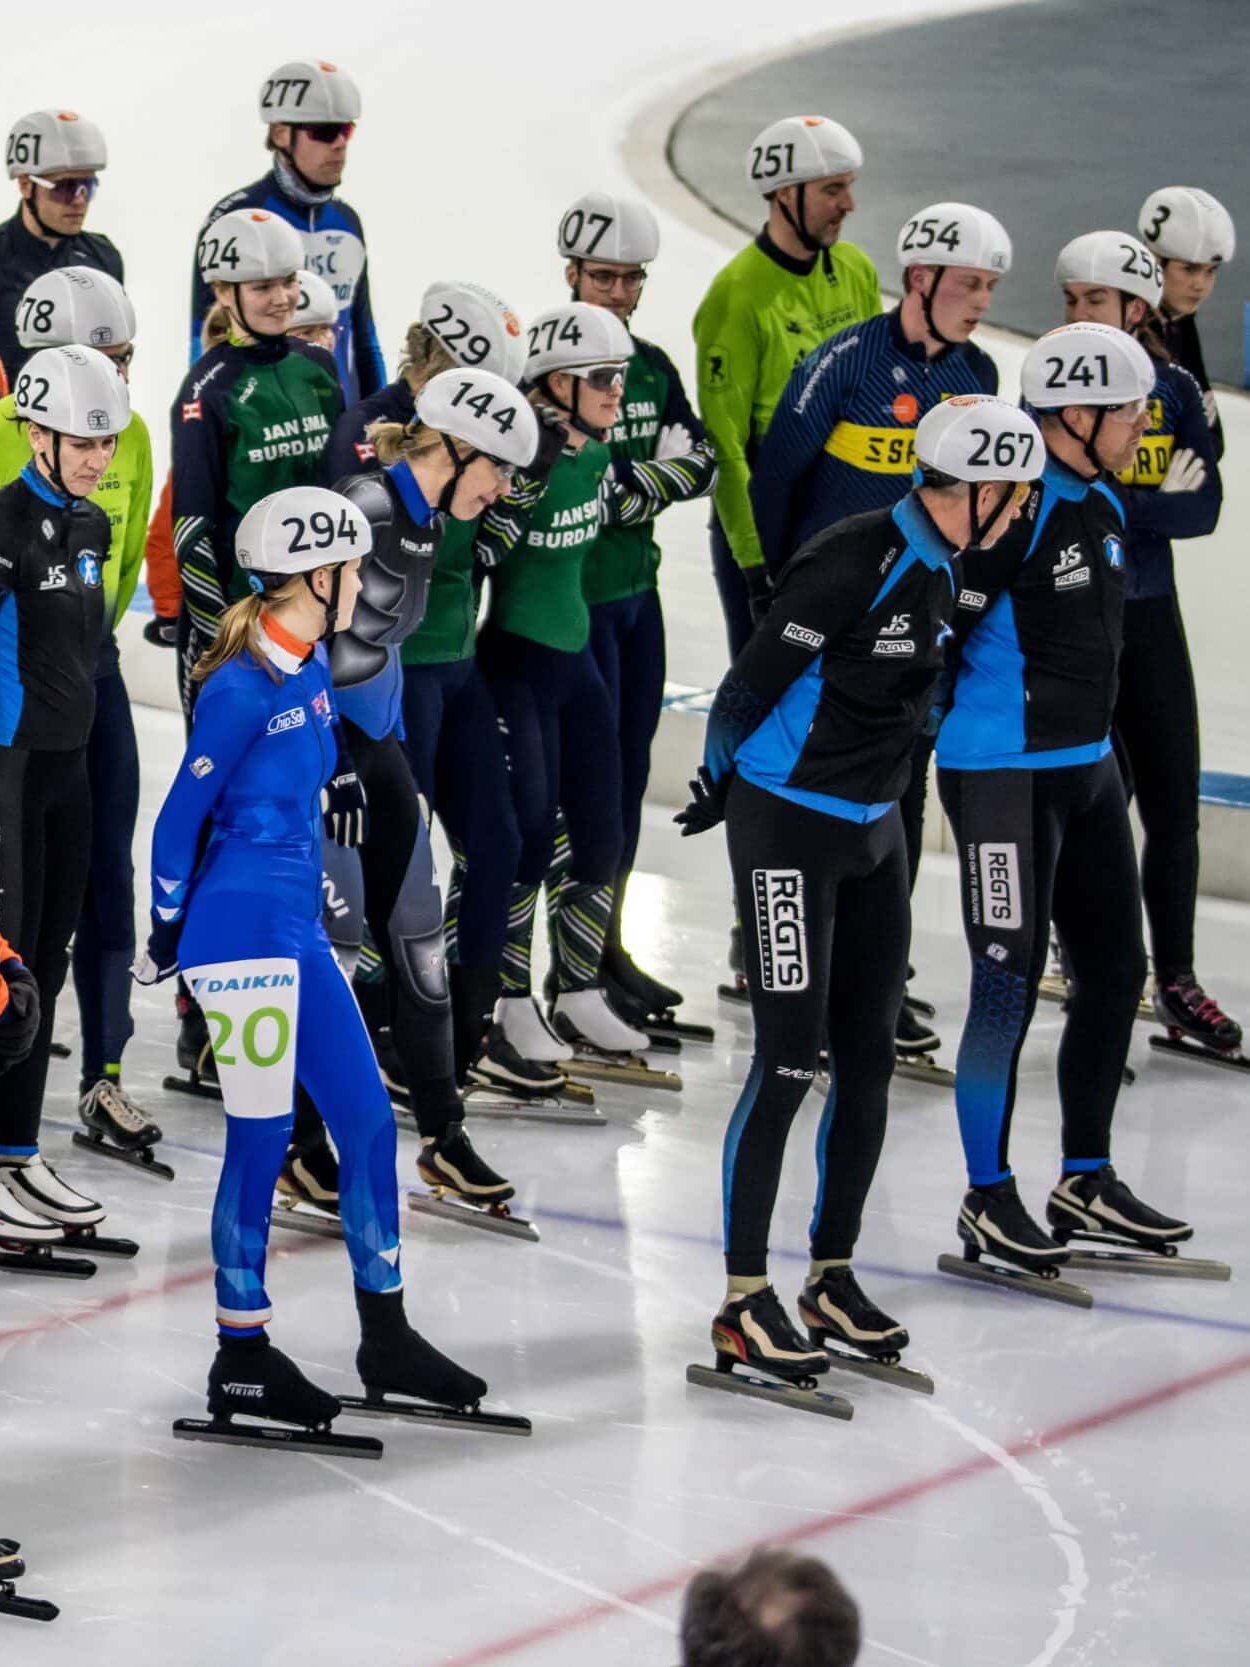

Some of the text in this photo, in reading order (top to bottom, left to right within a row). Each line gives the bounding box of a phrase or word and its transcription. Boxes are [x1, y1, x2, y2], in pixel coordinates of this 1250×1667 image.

[262, 80, 311, 108] 277
[6, 133, 43, 166] 261
[751, 143, 795, 179] 251
[561, 209, 614, 254] 07
[902, 219, 960, 252] 254
[199, 236, 240, 272] 224
[18, 297, 54, 333] 78
[428, 304, 491, 365] 229
[527, 316, 582, 356] 274
[1045, 355, 1110, 389] 241
[17, 374, 50, 412] 82
[450, 382, 517, 435] 144
[262, 419, 300, 442] JAN
[967, 429, 1034, 469] 267
[282, 509, 358, 554] 294
[551, 505, 583, 528] JAN
[988, 852, 1012, 920] REGTS
[770, 875, 804, 986] REGTS
[207, 974, 295, 993] DAIKIN
[205, 1006, 290, 1067] 20
[221, 1382, 265, 1398] VIKING
